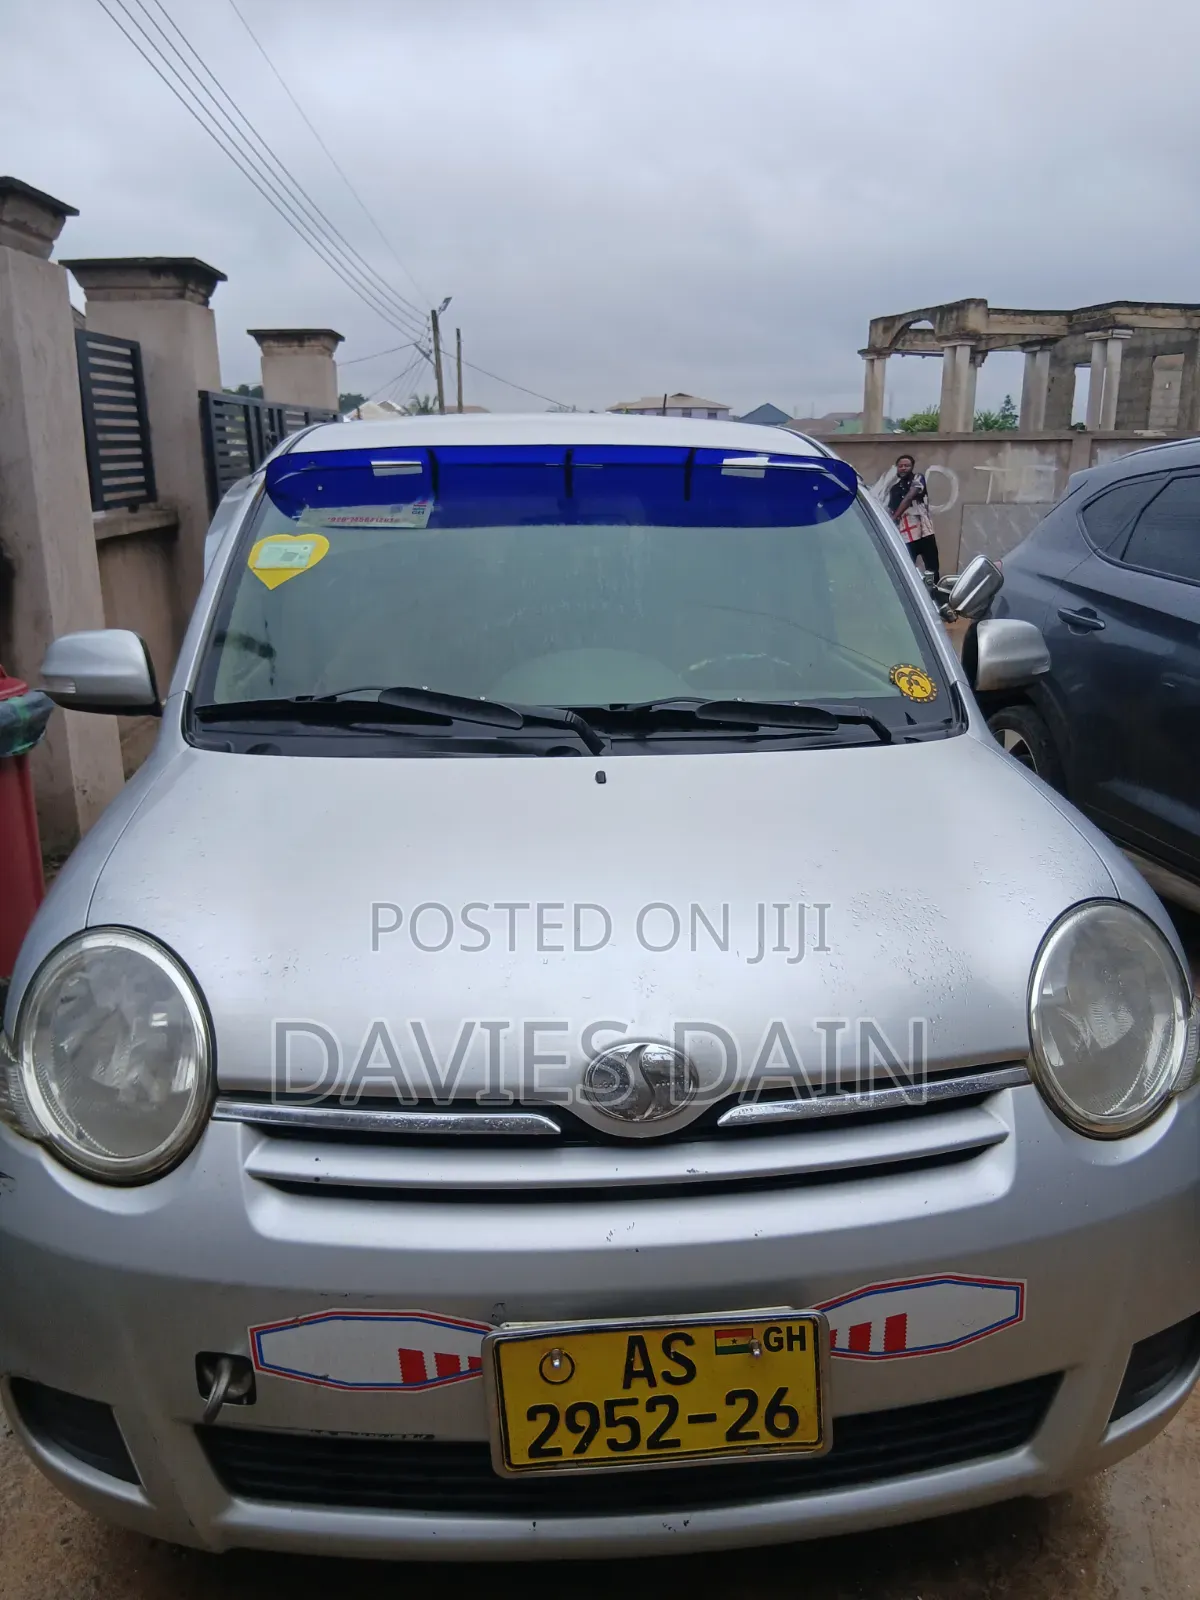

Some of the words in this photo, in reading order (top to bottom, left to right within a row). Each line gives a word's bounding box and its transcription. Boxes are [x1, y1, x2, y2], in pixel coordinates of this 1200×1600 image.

[623, 1332, 697, 1389] AS
[763, 1326, 806, 1352] GH
[526, 1387, 799, 1459] 2952-26
